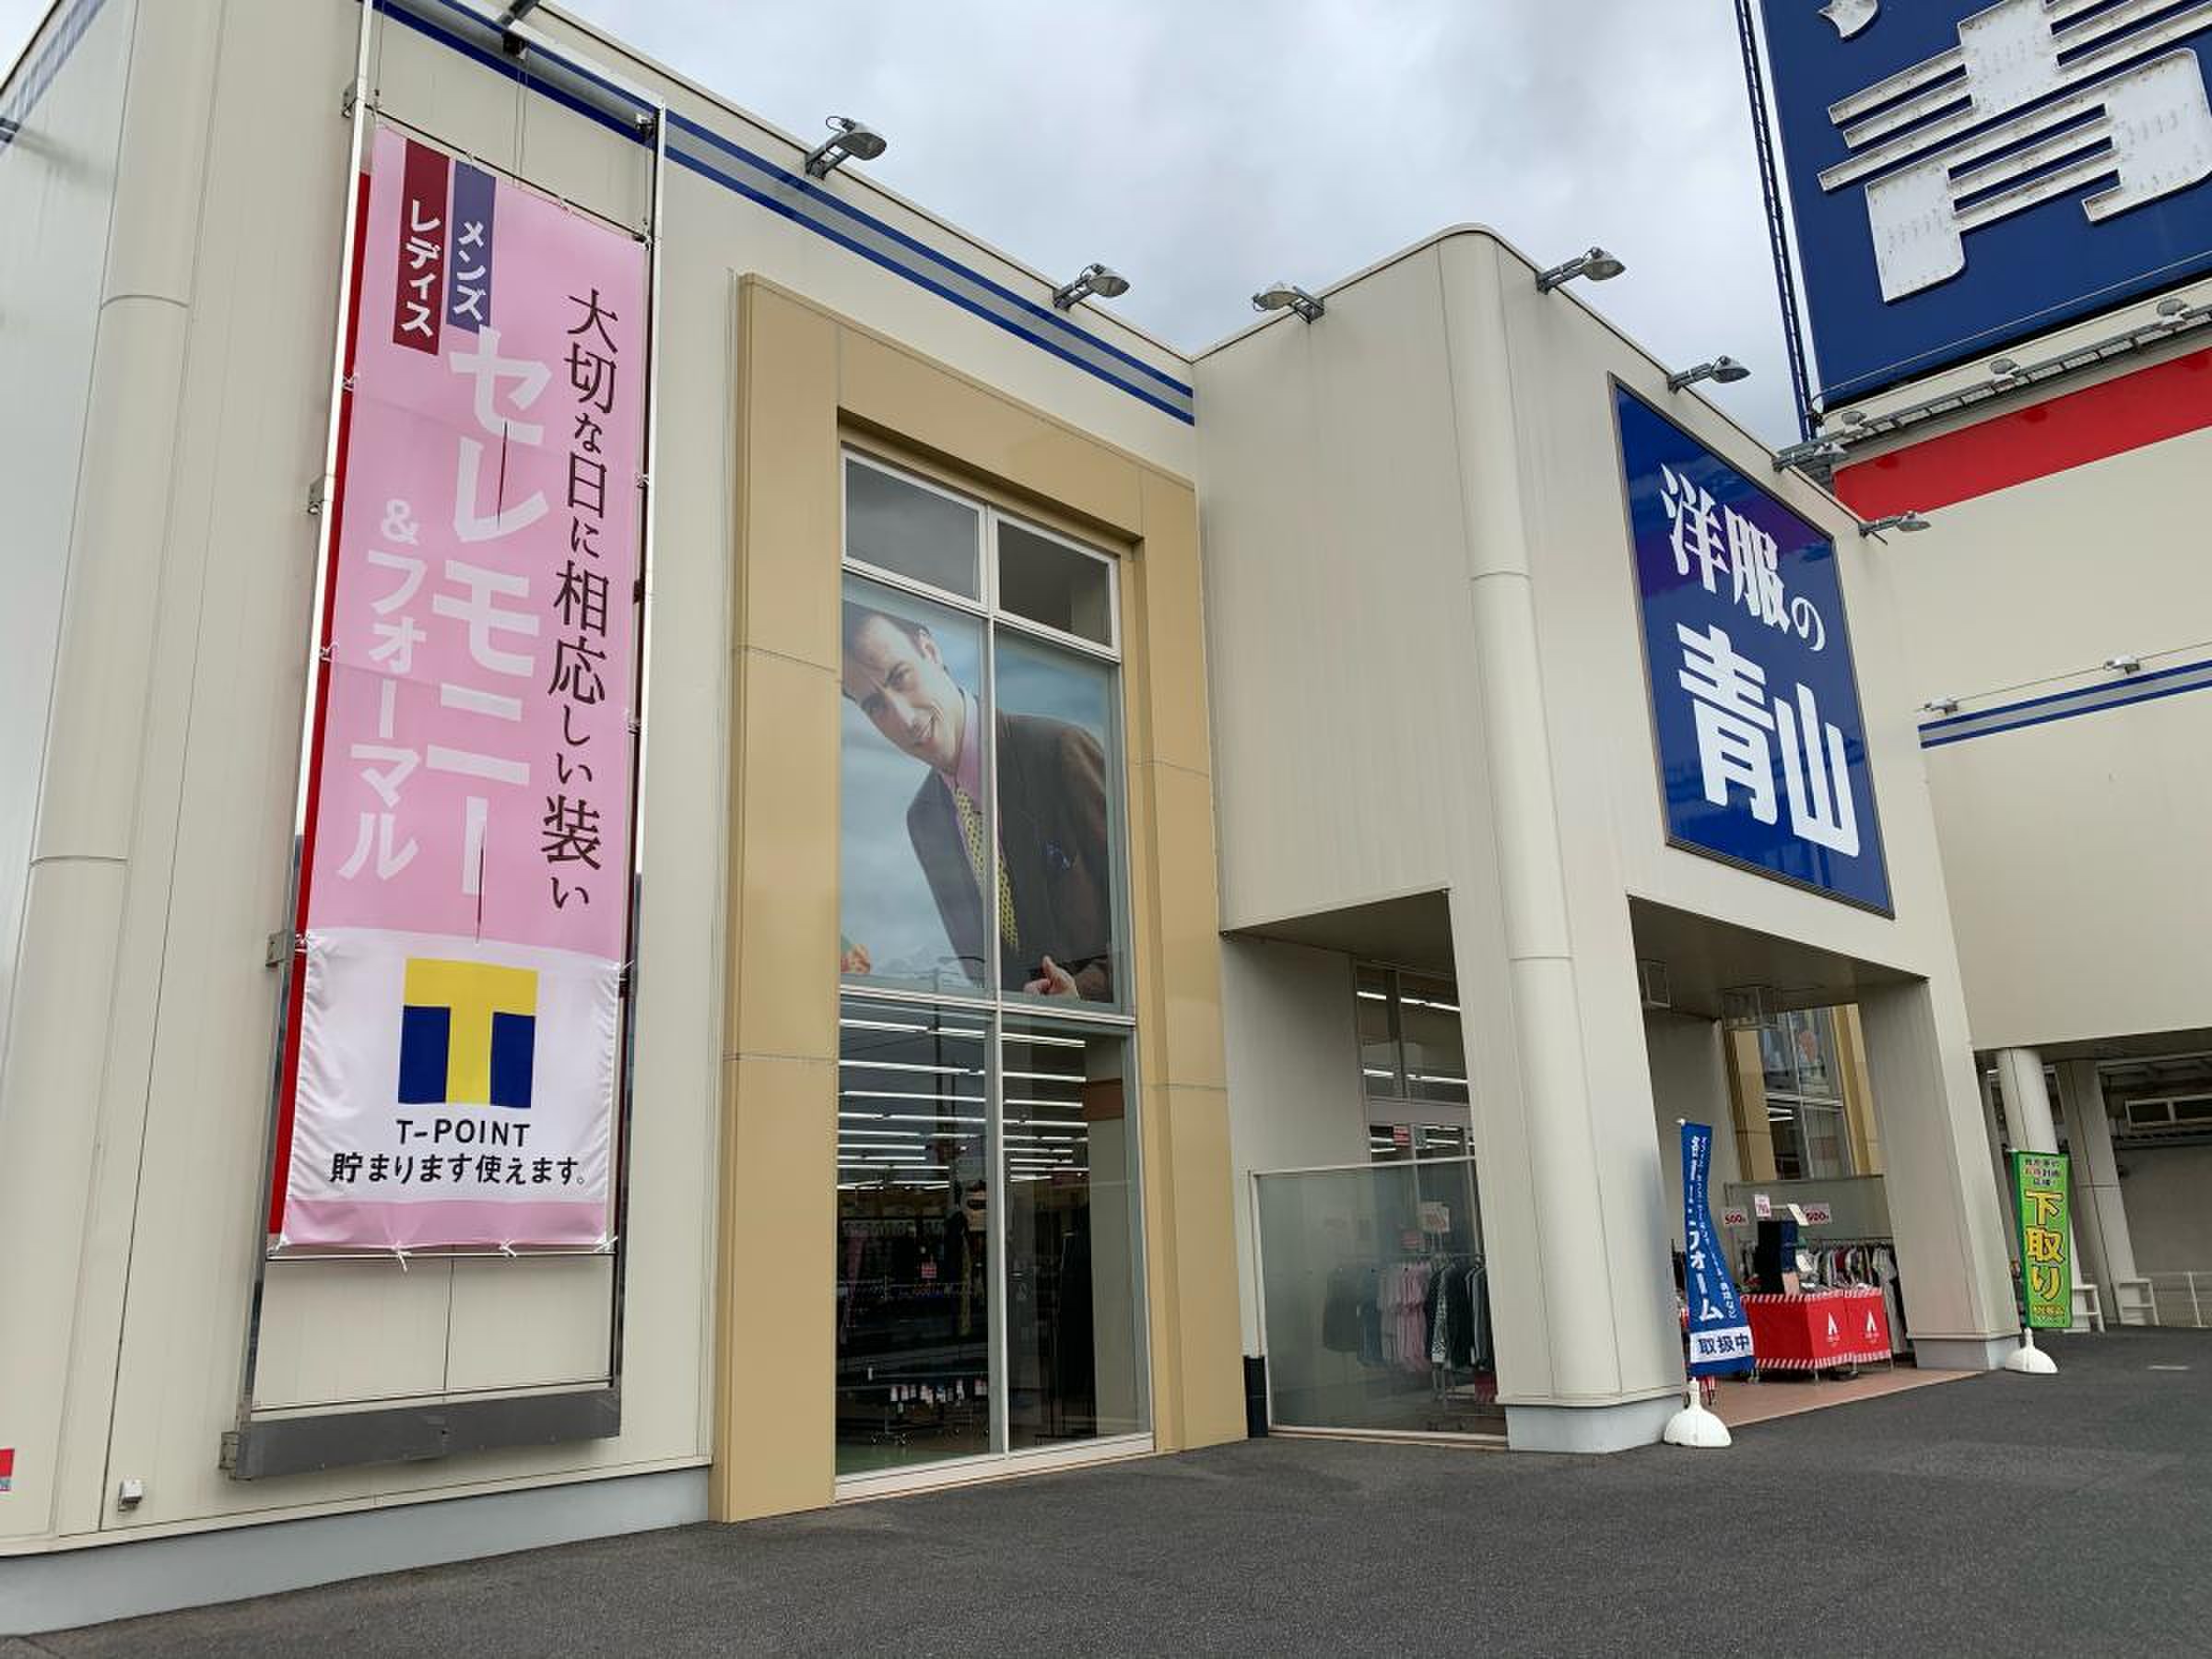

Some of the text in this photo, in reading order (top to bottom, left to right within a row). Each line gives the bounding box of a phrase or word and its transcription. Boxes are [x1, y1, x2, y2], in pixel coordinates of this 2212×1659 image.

[400, 199, 441, 338] レディス
[452, 220, 487, 323] メンズ
[426, 324, 552, 895] セレモニー
[540, 287, 619, 910] 大切な日に相応しい装い
[1659, 462, 1827, 652] 洋服の
[1677, 622, 1860, 858] 青山
[329, 1152, 585, 1185] 貯まります使えます。
[395, 1119, 531, 1147] T-POINT
[2025, 1189, 2065, 1301] 下取り
[1697, 1332, 1750, 1355] 取扱中
